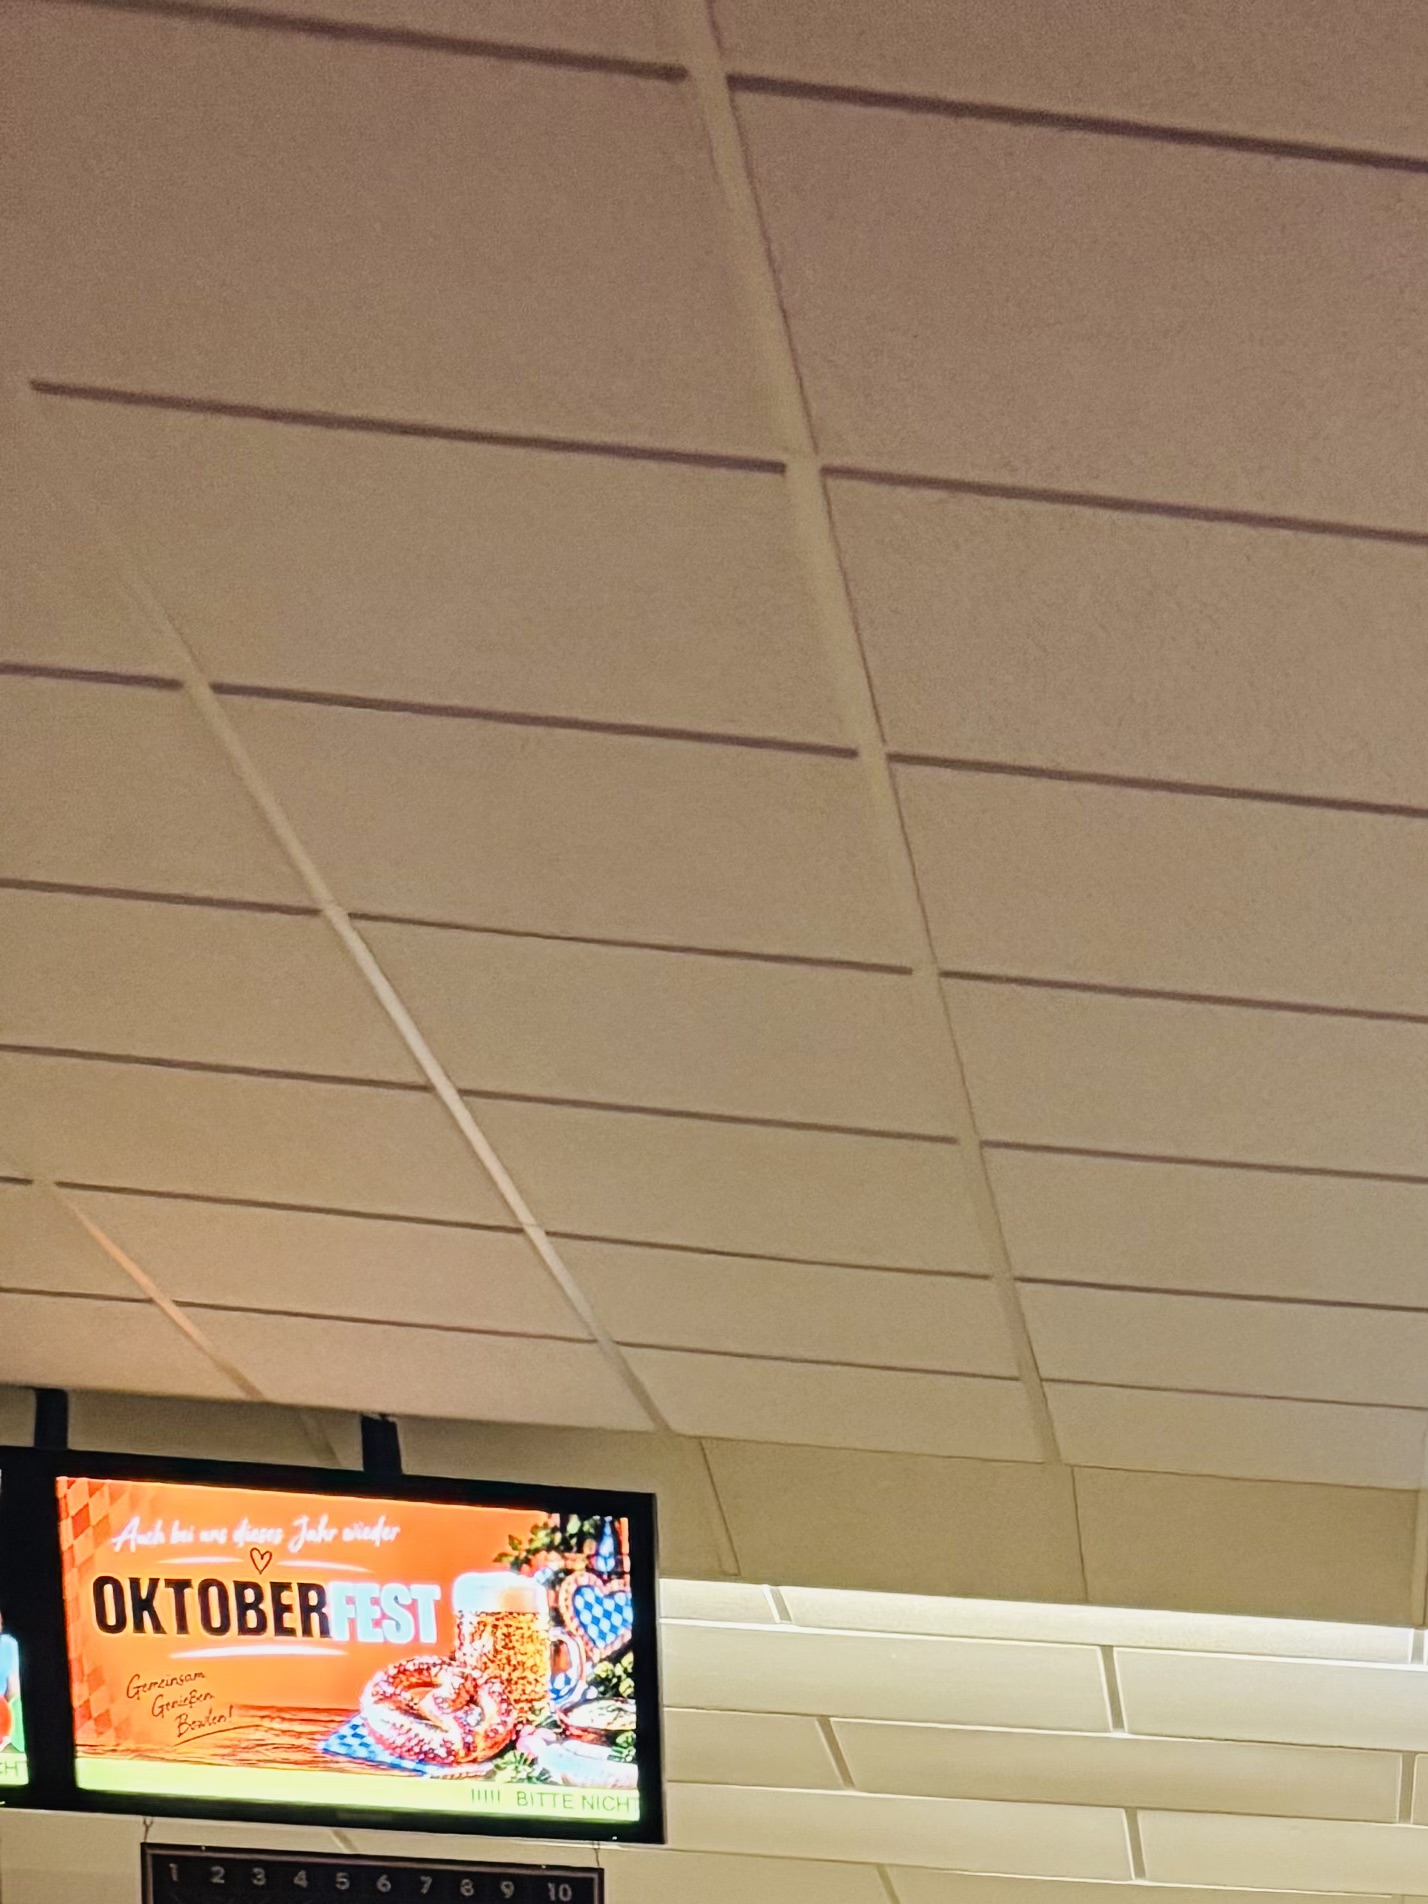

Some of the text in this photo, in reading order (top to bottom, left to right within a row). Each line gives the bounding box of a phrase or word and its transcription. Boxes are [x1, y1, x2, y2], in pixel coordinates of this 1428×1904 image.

[171, 1521, 194, 1543] bei
[200, 1527, 226, 1544] uns
[234, 1517, 282, 1548] dieses
[288, 1515, 338, 1554] Jahr
[342, 1515, 401, 1548] wieder
[93, 1576, 441, 1645] OKTOBERFEST
[126, 1670, 207, 1700] Gemeinsam
[175, 1704, 235, 1737] Bowlen!
[517, 1790, 575, 1811] BITTE
